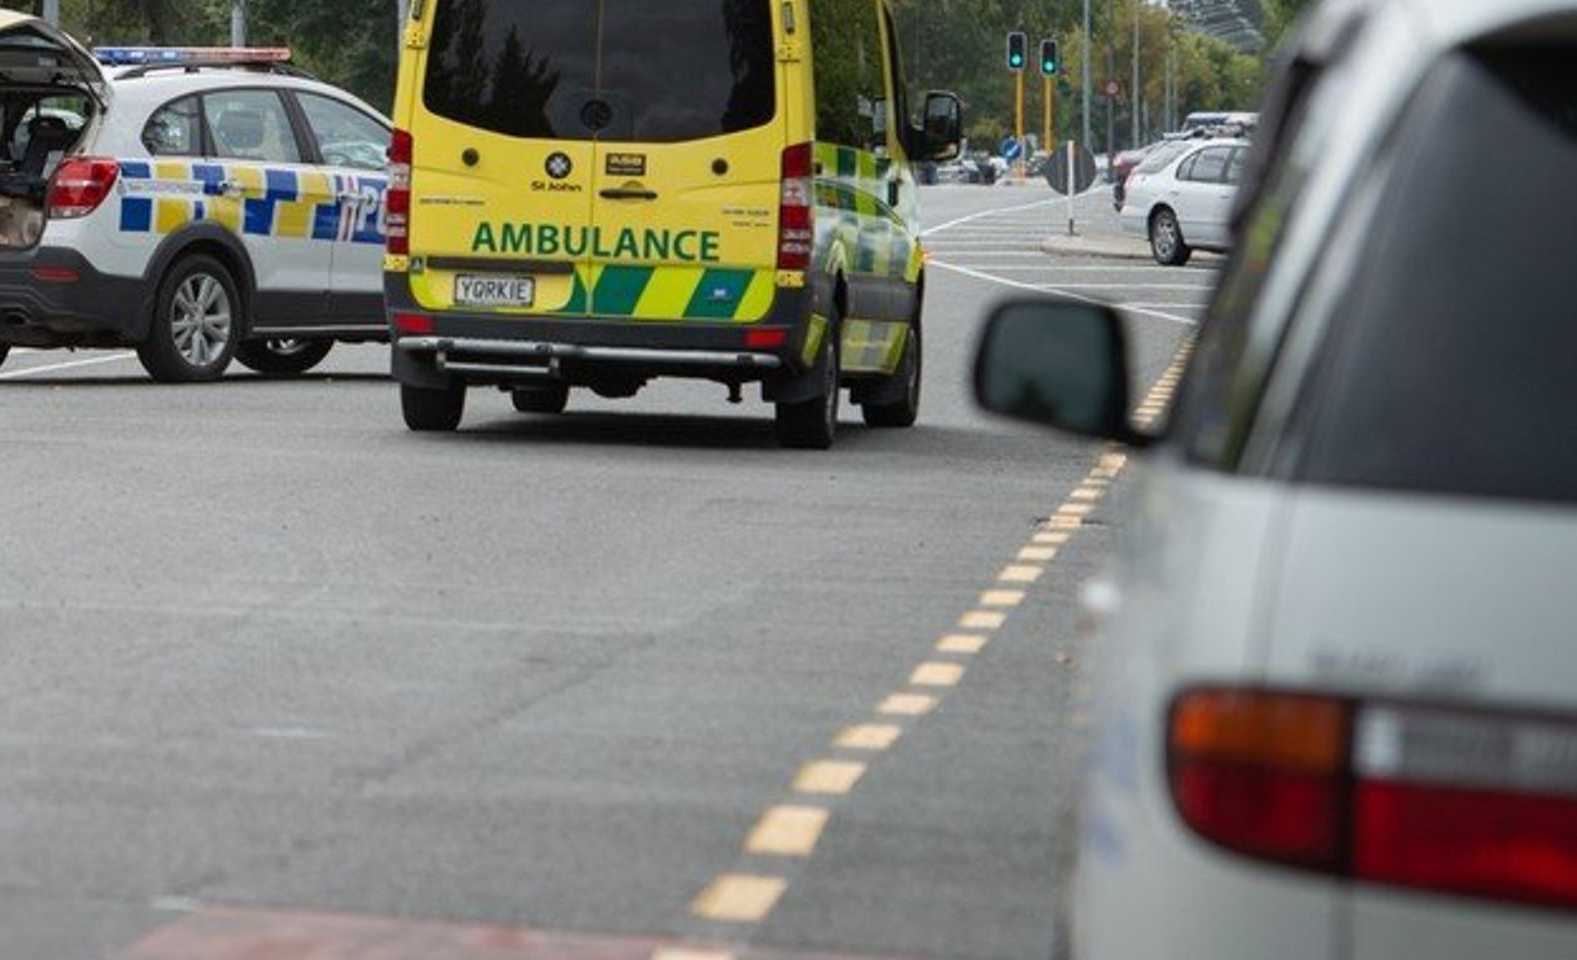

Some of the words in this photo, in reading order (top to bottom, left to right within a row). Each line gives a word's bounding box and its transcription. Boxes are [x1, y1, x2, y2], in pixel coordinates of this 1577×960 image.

[547, 181, 582, 193] John
[472, 222, 721, 261] AMBULANCE
[460, 278, 527, 301] YORKIE
